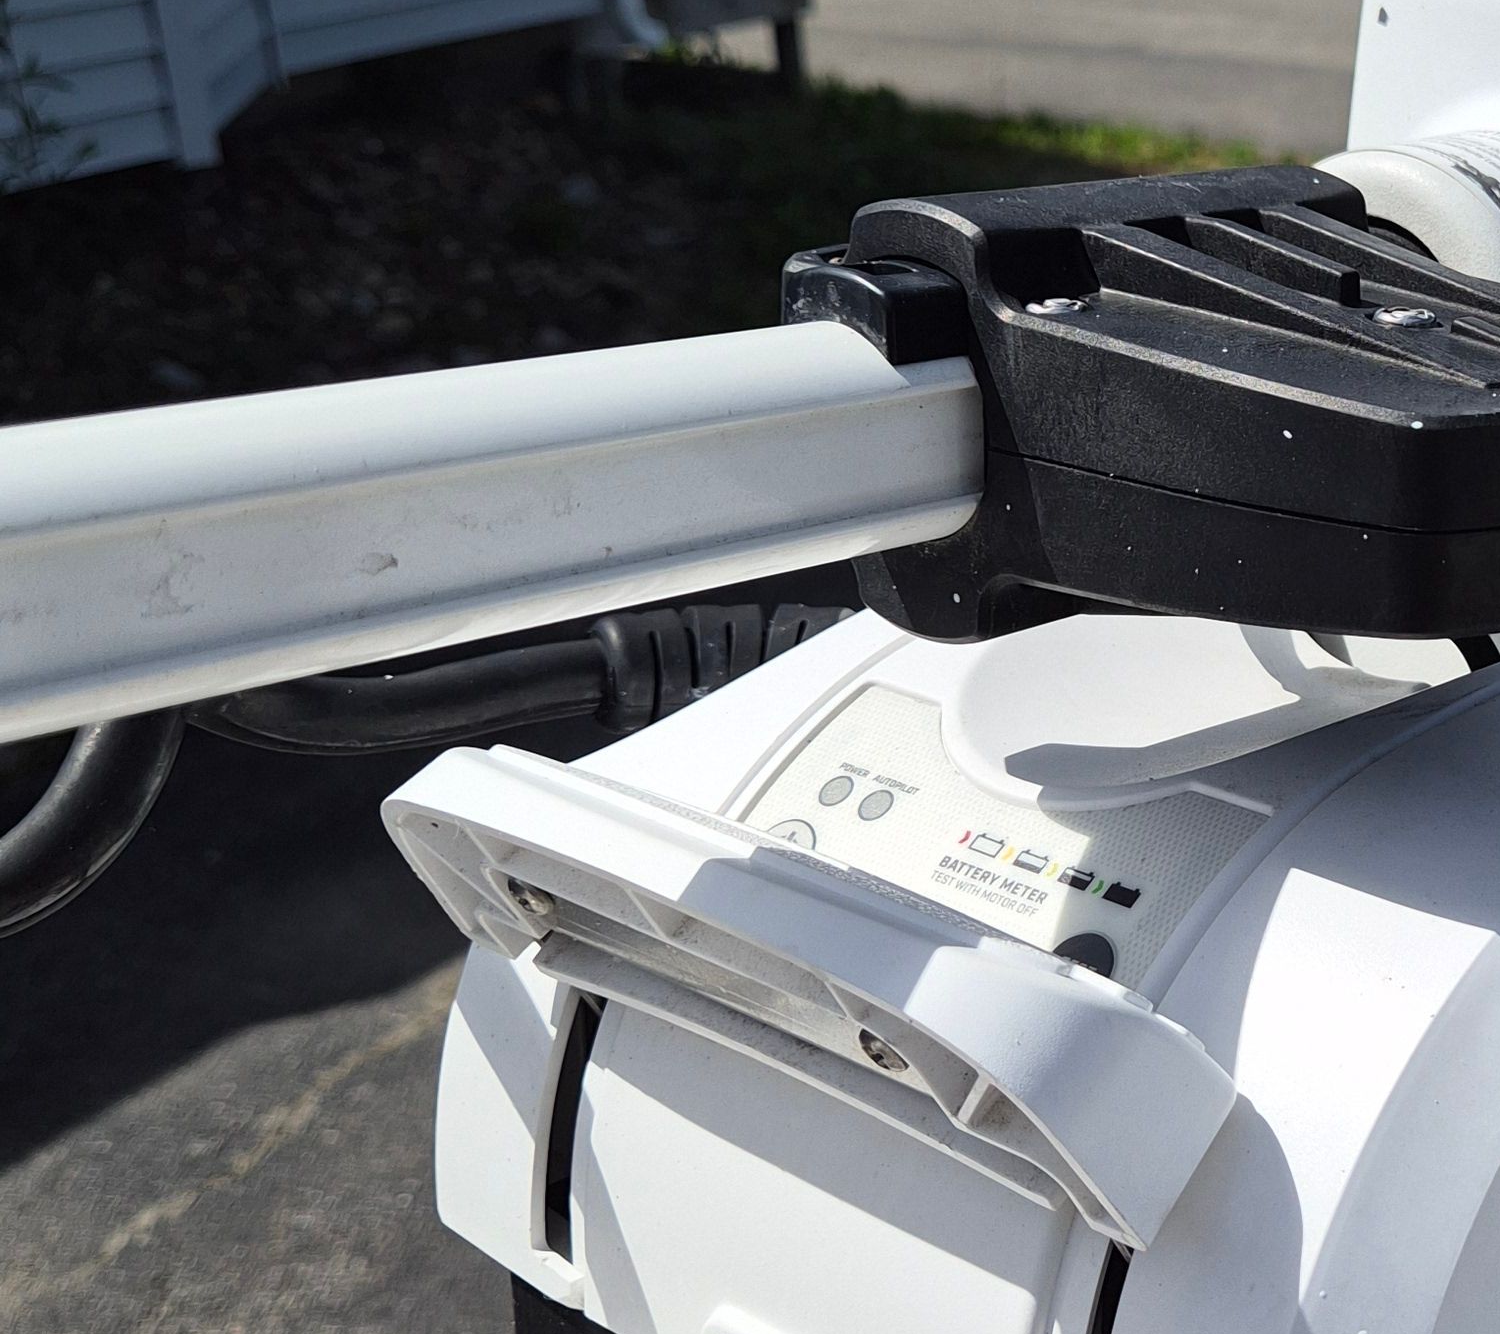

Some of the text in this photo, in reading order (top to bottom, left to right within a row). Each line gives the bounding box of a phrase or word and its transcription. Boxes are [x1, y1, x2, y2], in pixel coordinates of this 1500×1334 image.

[840, 762, 871, 778] POWER
[872, 775, 920, 795] AUTOPILOT
[930, 870, 1040, 918] TEST WITH MOTOR OFF
[939, 855, 1049, 905] BATTERY METER
